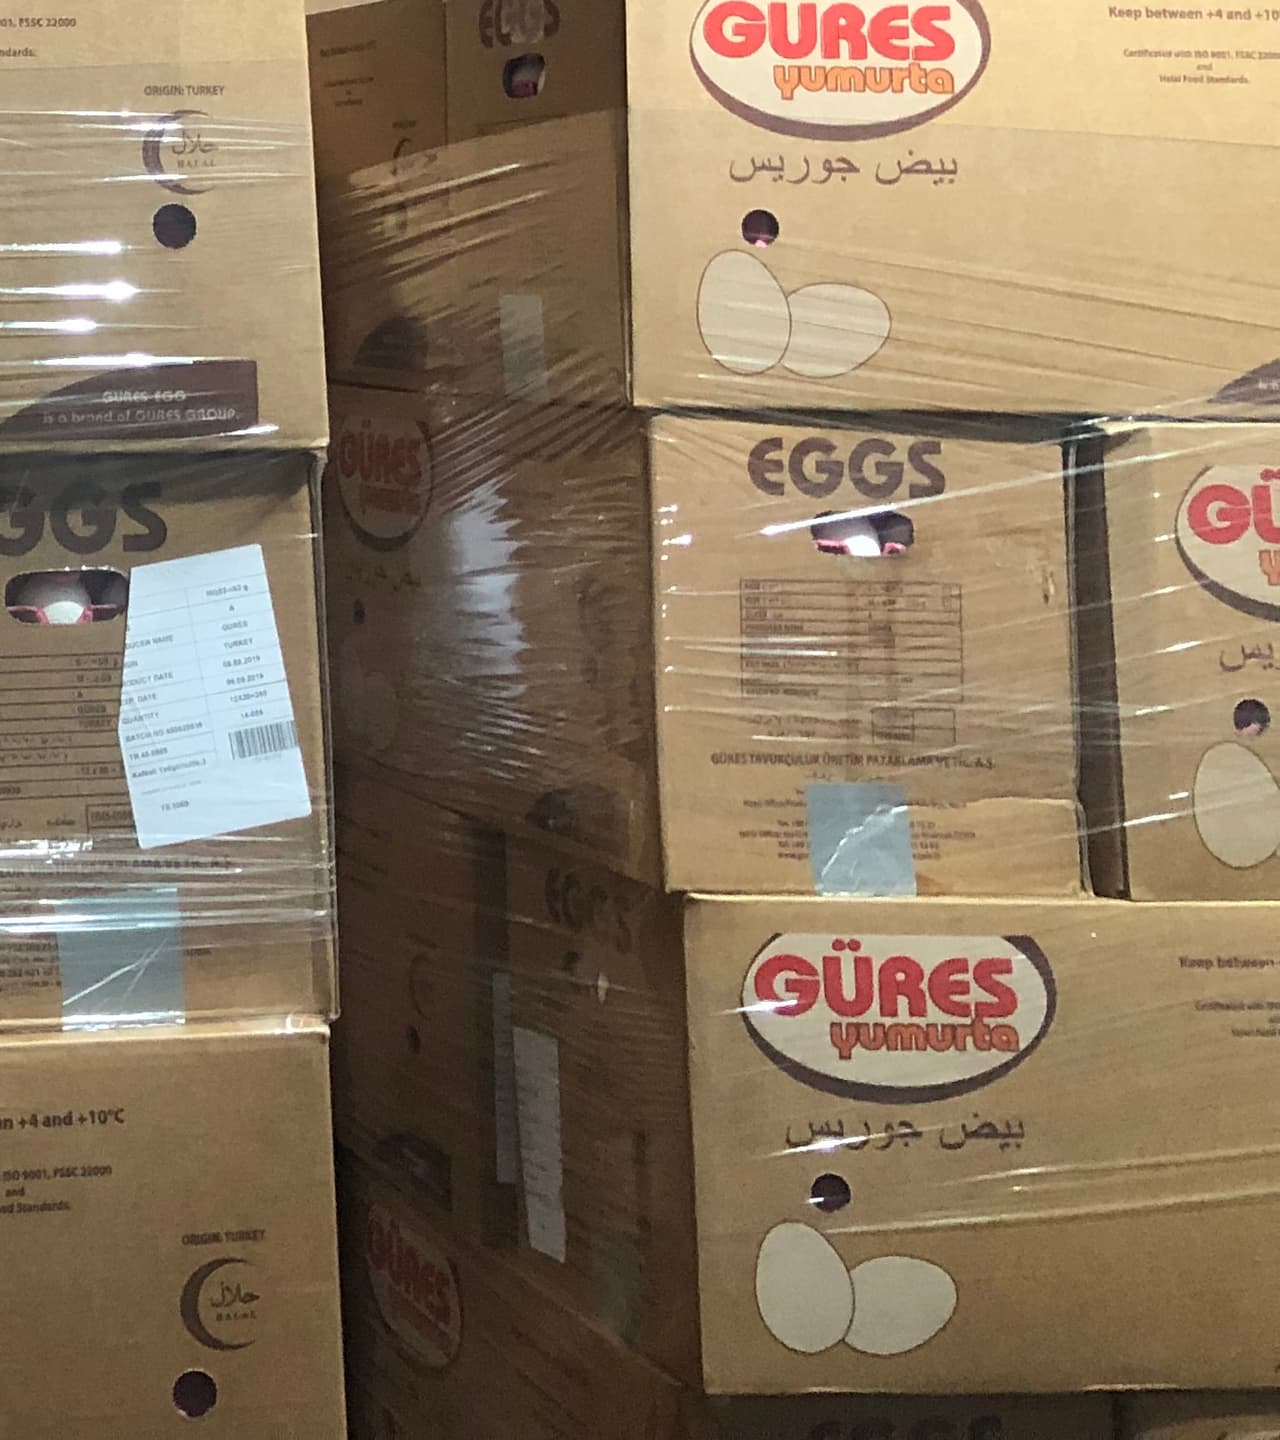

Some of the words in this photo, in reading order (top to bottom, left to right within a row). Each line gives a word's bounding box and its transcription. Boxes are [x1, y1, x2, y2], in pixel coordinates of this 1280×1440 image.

[46, 18, 76, 28] 22000
[1108, 6, 1142, 20] Keep
[1146, 8, 1202, 19] between
[1206, 9, 1222, 19] +4
[1226, 9, 1252, 20] and
[144, 86, 184, 96] ORIGIN:
[186, 86, 224, 96] TURKEY
[774, 64, 954, 100] yumurta
[729, 151, 860, 184] جوريس
[876, 150, 958, 186] بيض
[748, 437, 946, 498] EGGS
[754, 938, 1018, 1018] GÜRES
[830, 1019, 1019, 1060] yumurta
[18, 1116, 38, 1128] +4
[42, 1112, 72, 1126] and
[78, 1108, 125, 1124] +10°C
[940, 1114, 1024, 1151] بيض
[5, 1188, 25, 1198] and
